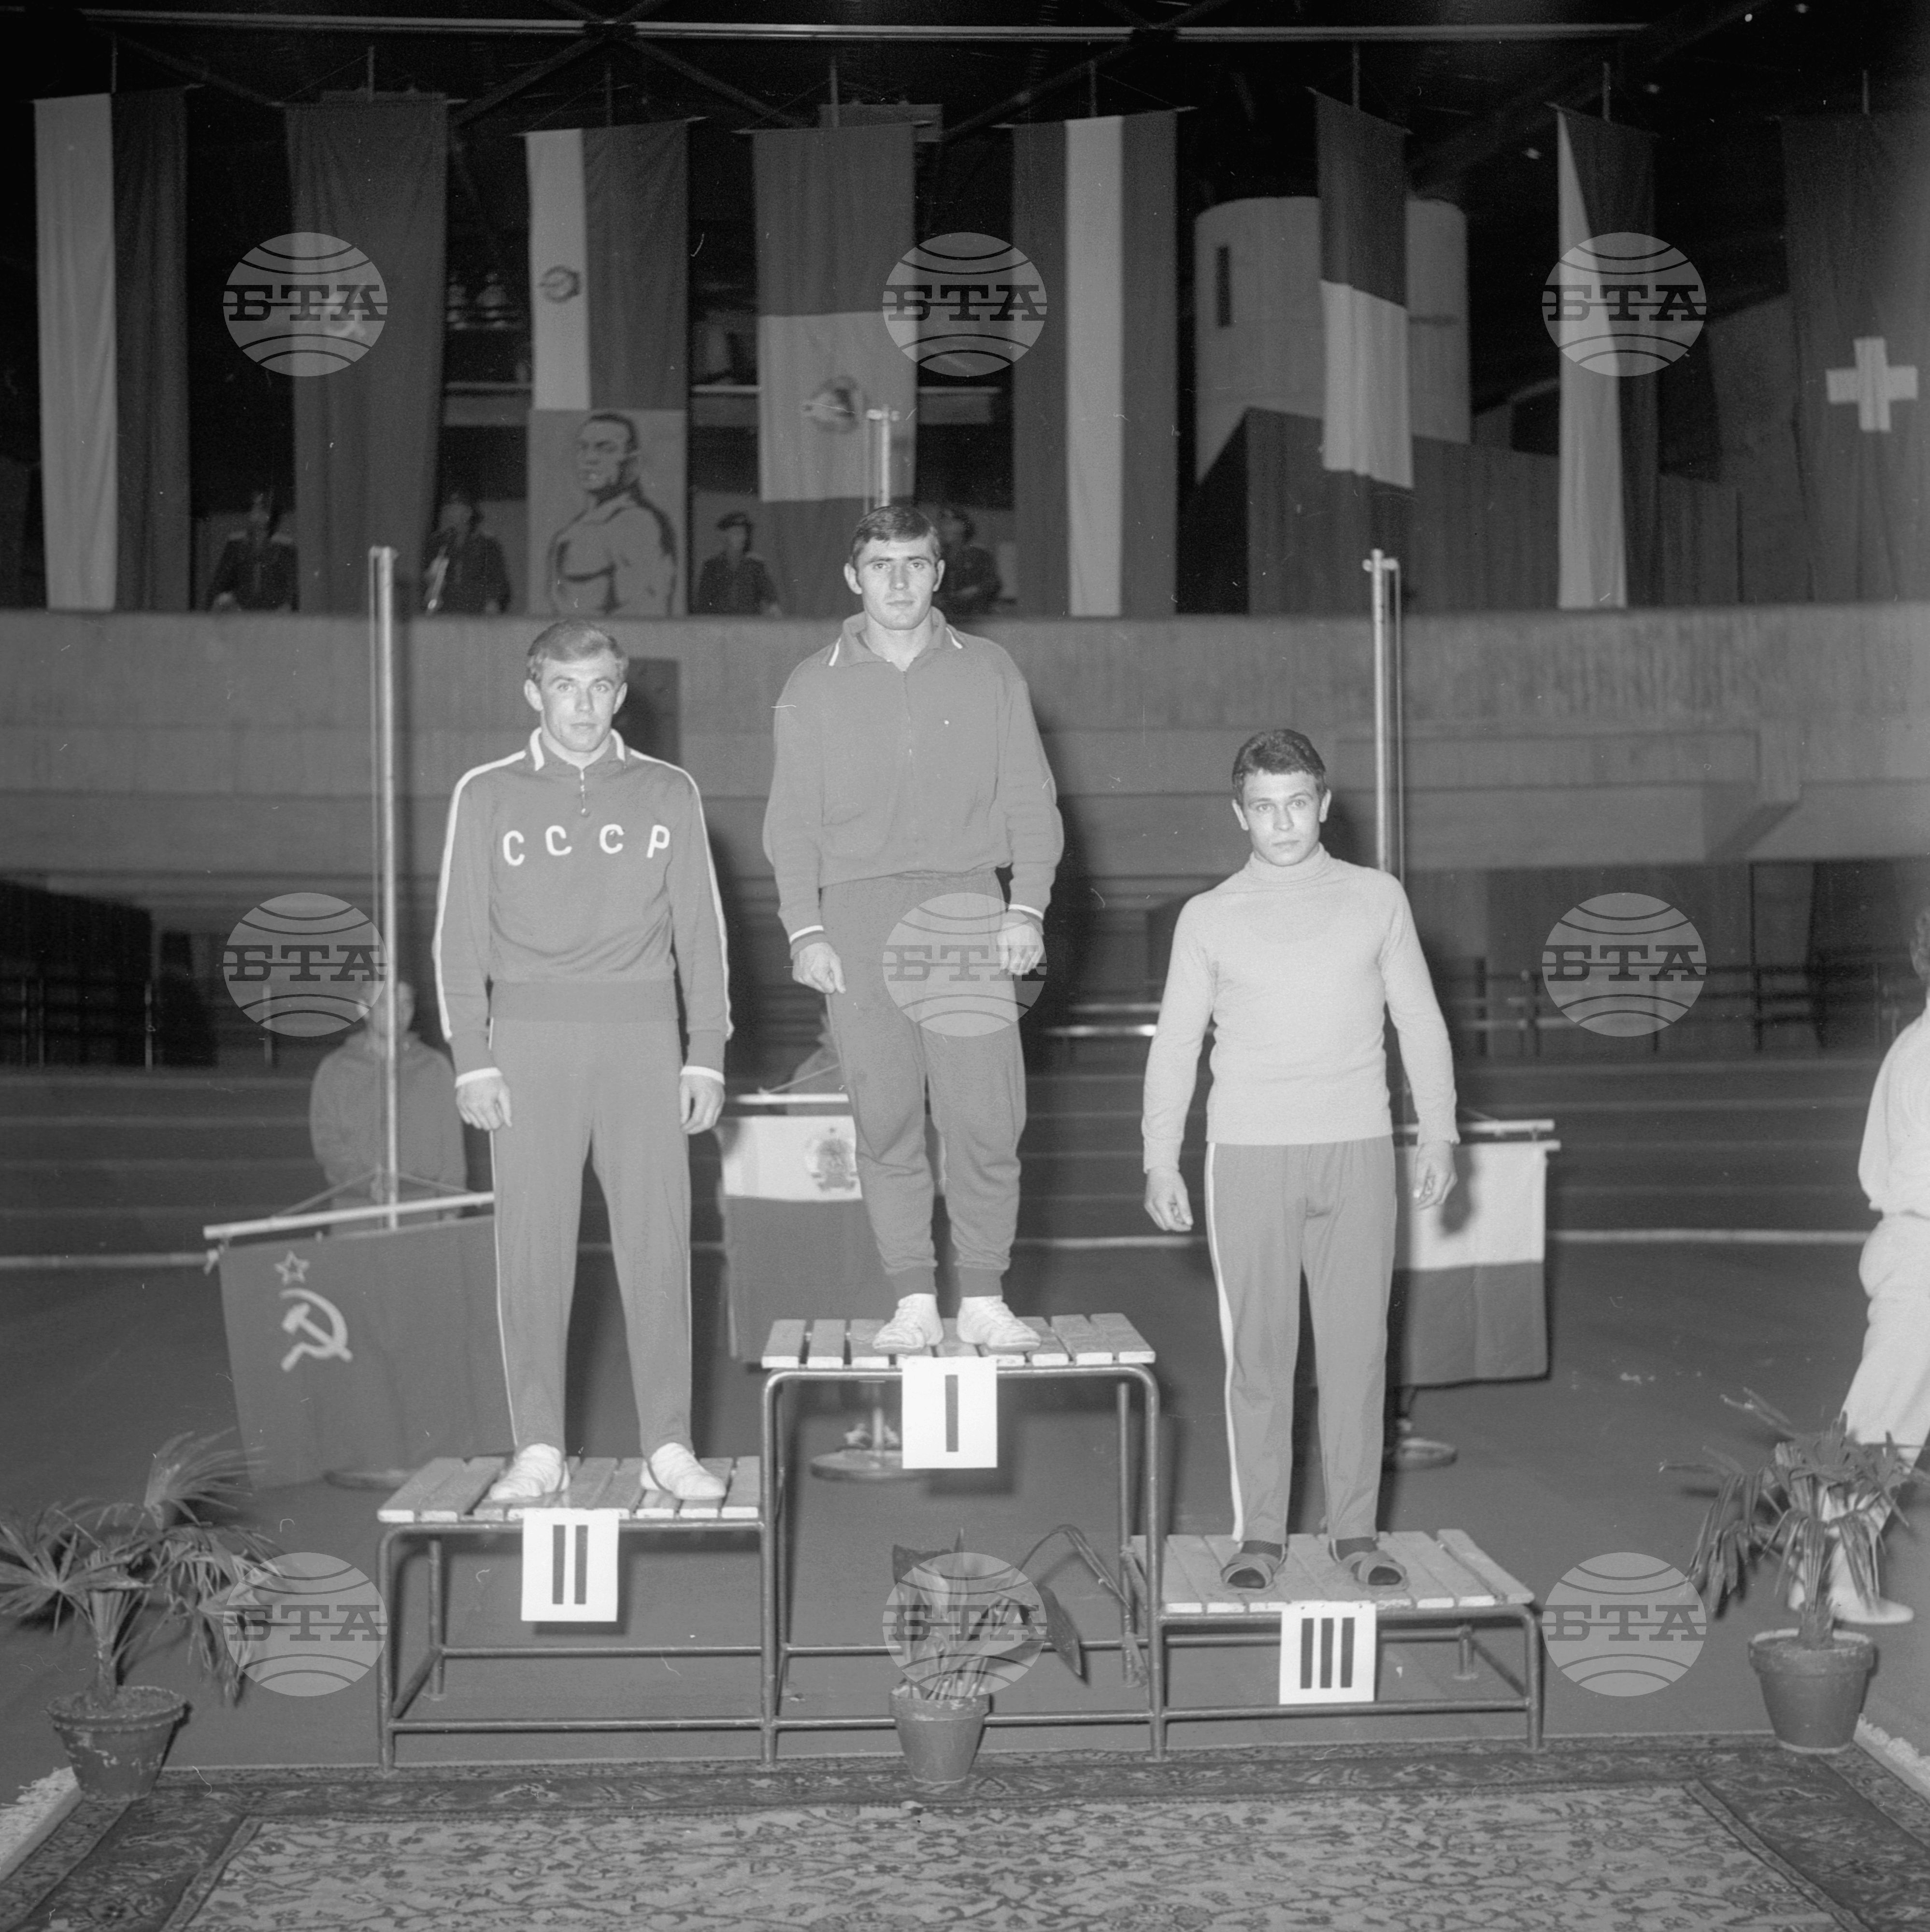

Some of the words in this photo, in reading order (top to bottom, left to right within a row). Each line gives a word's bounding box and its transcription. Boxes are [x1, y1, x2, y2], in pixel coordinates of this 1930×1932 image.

[503, 824, 670, 866] СССР
[945, 1375, 958, 1452] I
[552, 1525, 588, 1605] II
[1300, 1618, 1355, 1689] III
